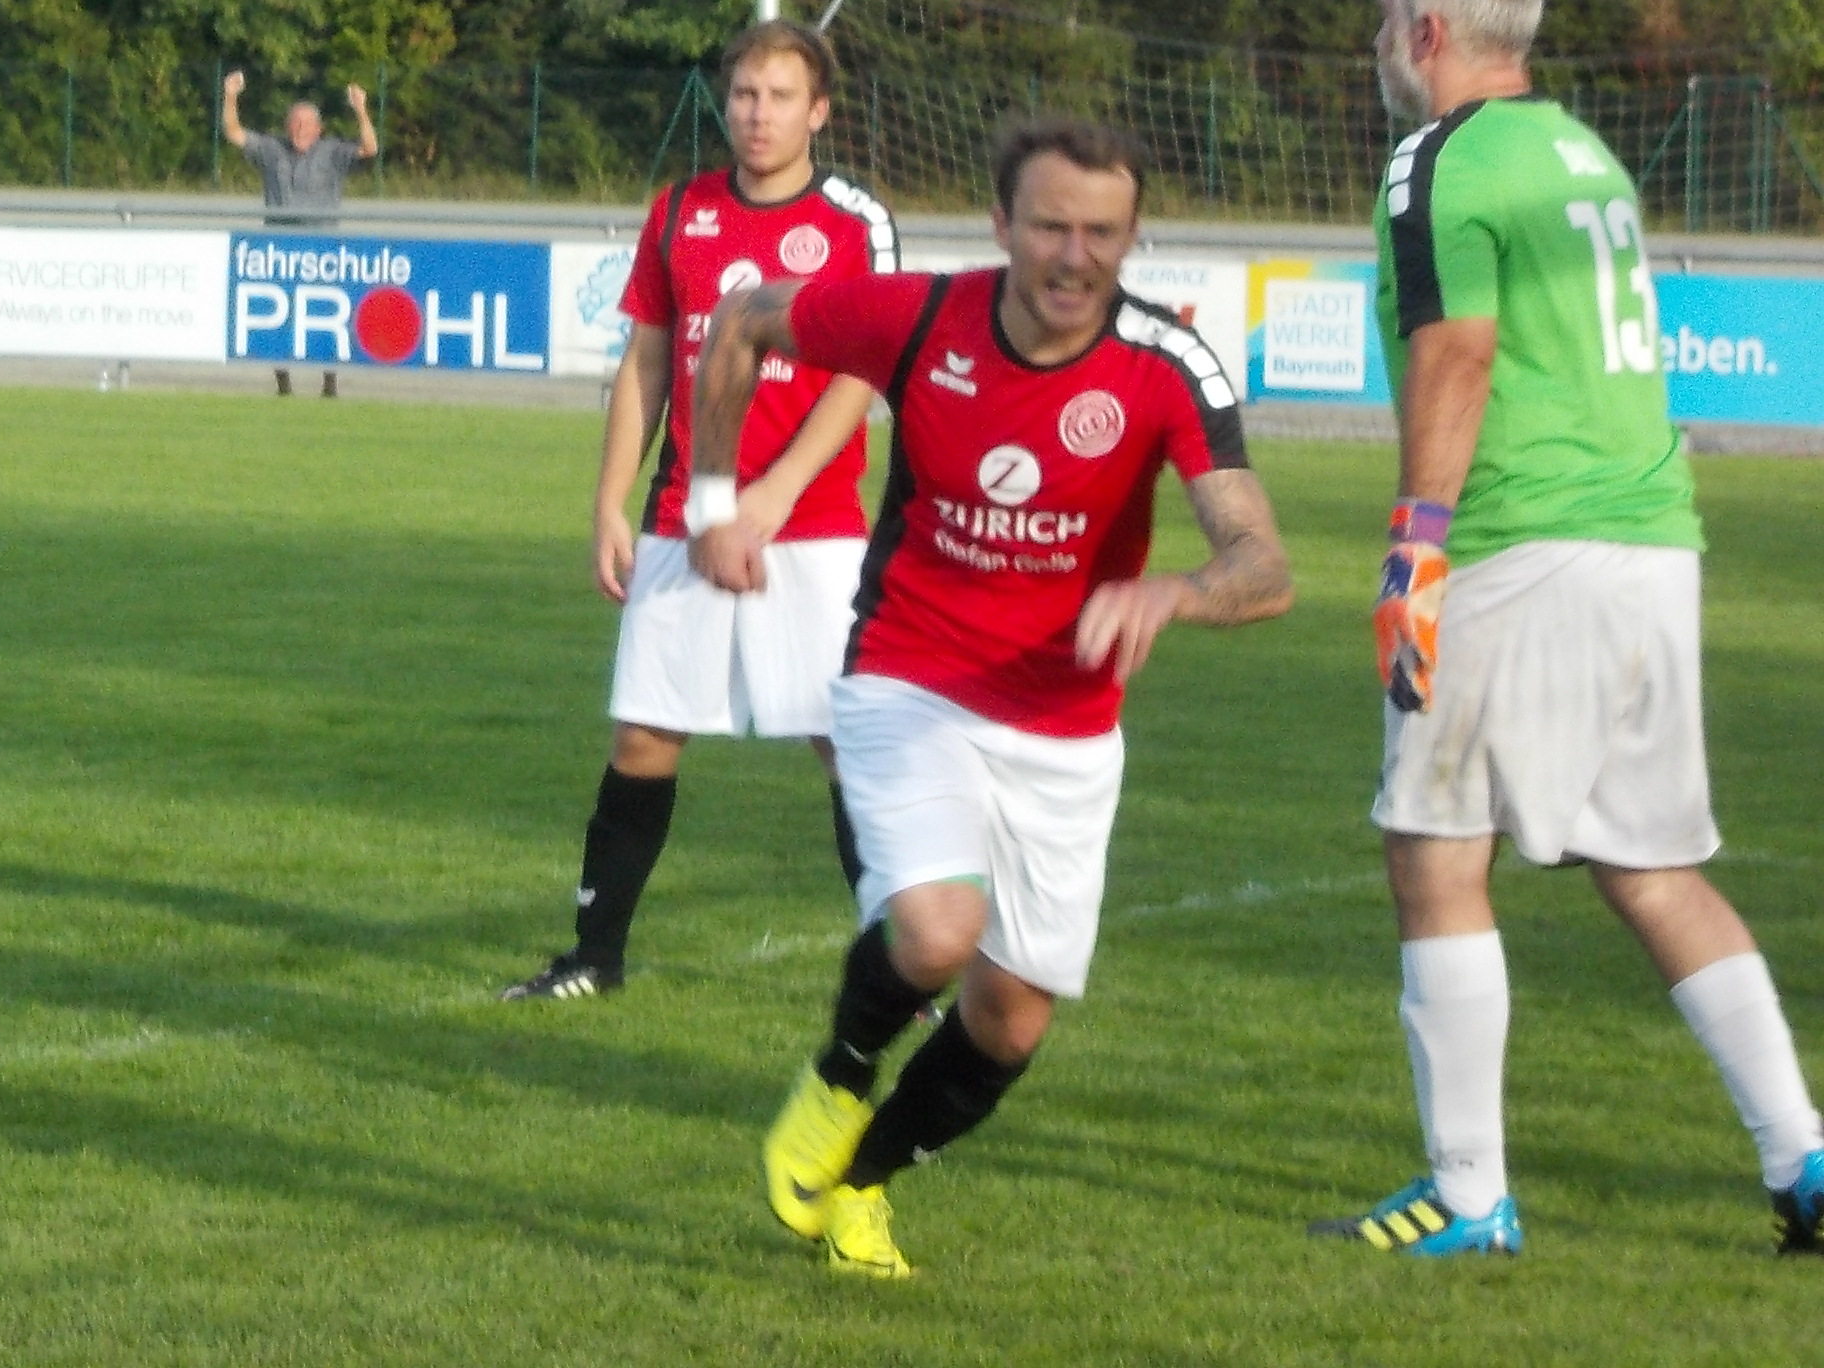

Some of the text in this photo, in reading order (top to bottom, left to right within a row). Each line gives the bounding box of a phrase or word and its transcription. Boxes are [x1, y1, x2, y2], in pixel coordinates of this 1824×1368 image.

[237, 240, 412, 285] fahrschule
[1565, 198, 1659, 374] 13
[1273, 291, 1354, 318] STADT
[1272, 320, 1352, 347] WERKE
[1660, 324, 1779, 375] eben.
[1273, 355, 1356, 377] Bayreuth
